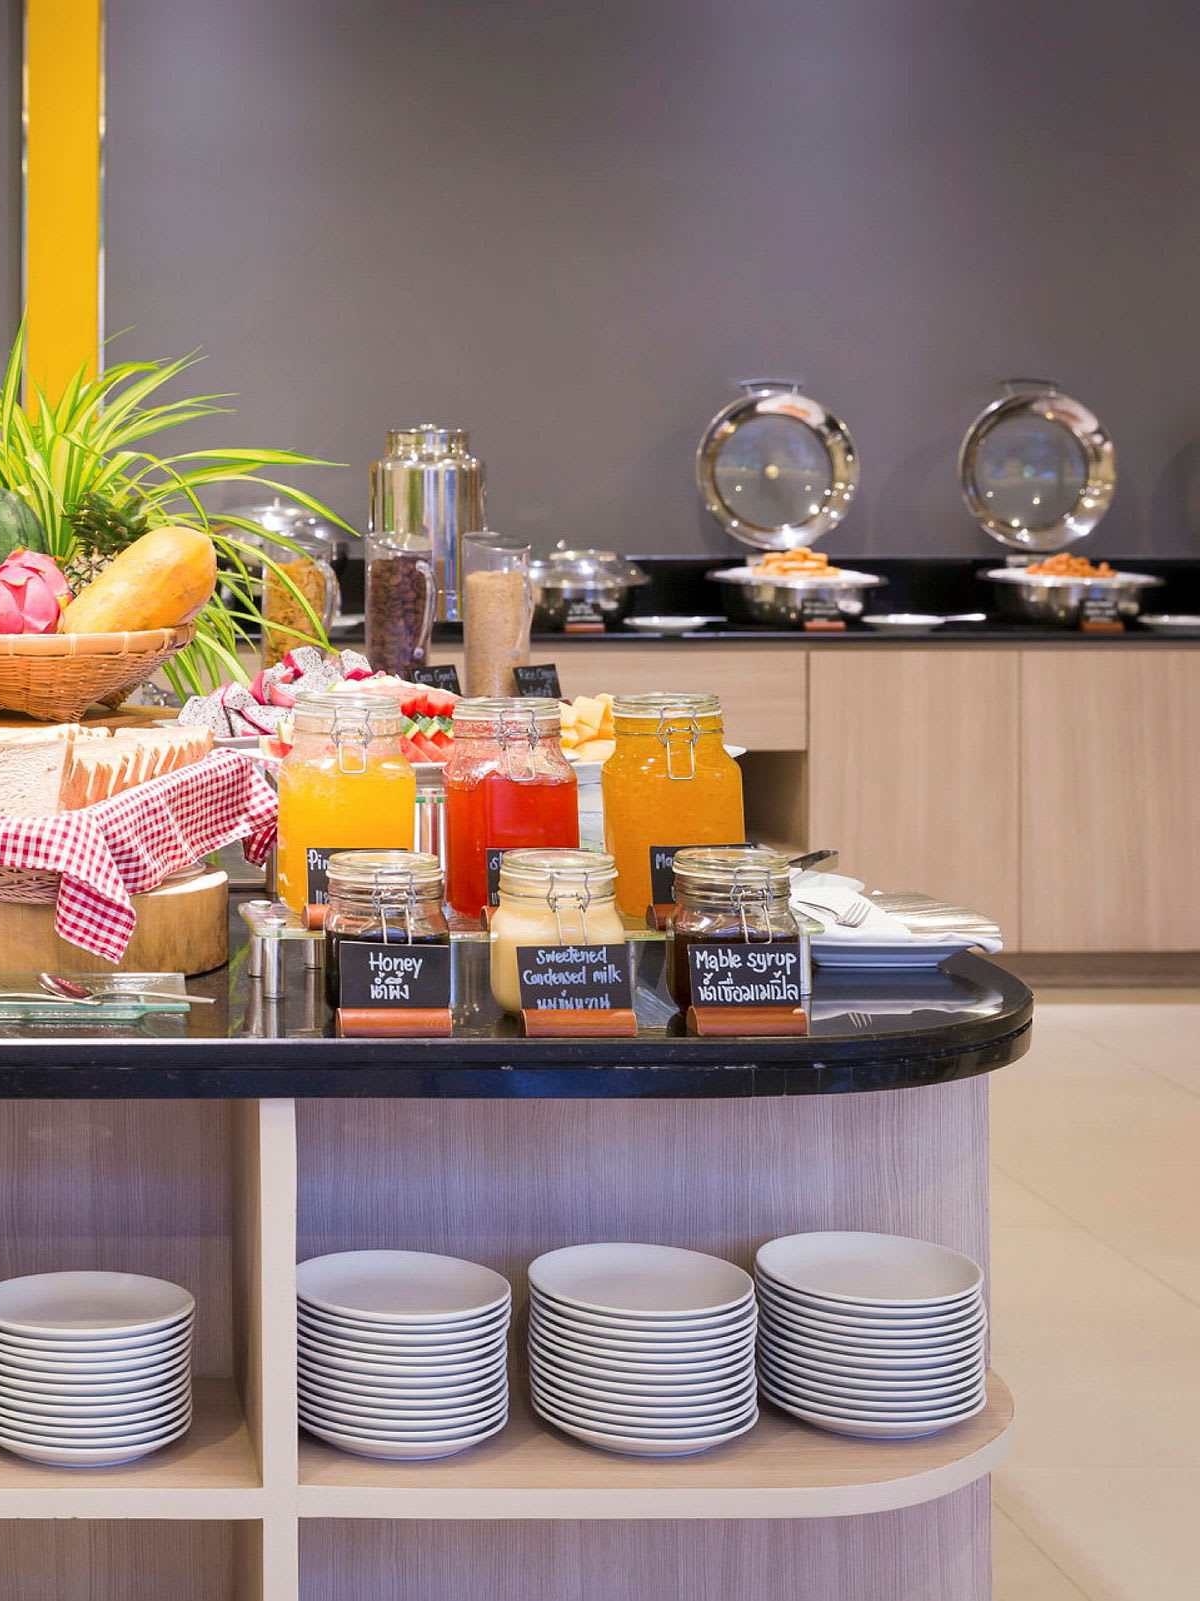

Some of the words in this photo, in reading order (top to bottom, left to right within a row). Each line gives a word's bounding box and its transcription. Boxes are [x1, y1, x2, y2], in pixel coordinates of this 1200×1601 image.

[368, 951, 423, 979] Honey
[536, 946, 607, 965] Sweetened
[695, 948, 743, 972] Mable
[746, 951, 797, 975] syrup
[522, 965, 587, 986] Condensed
[592, 963, 622, 984] milk
